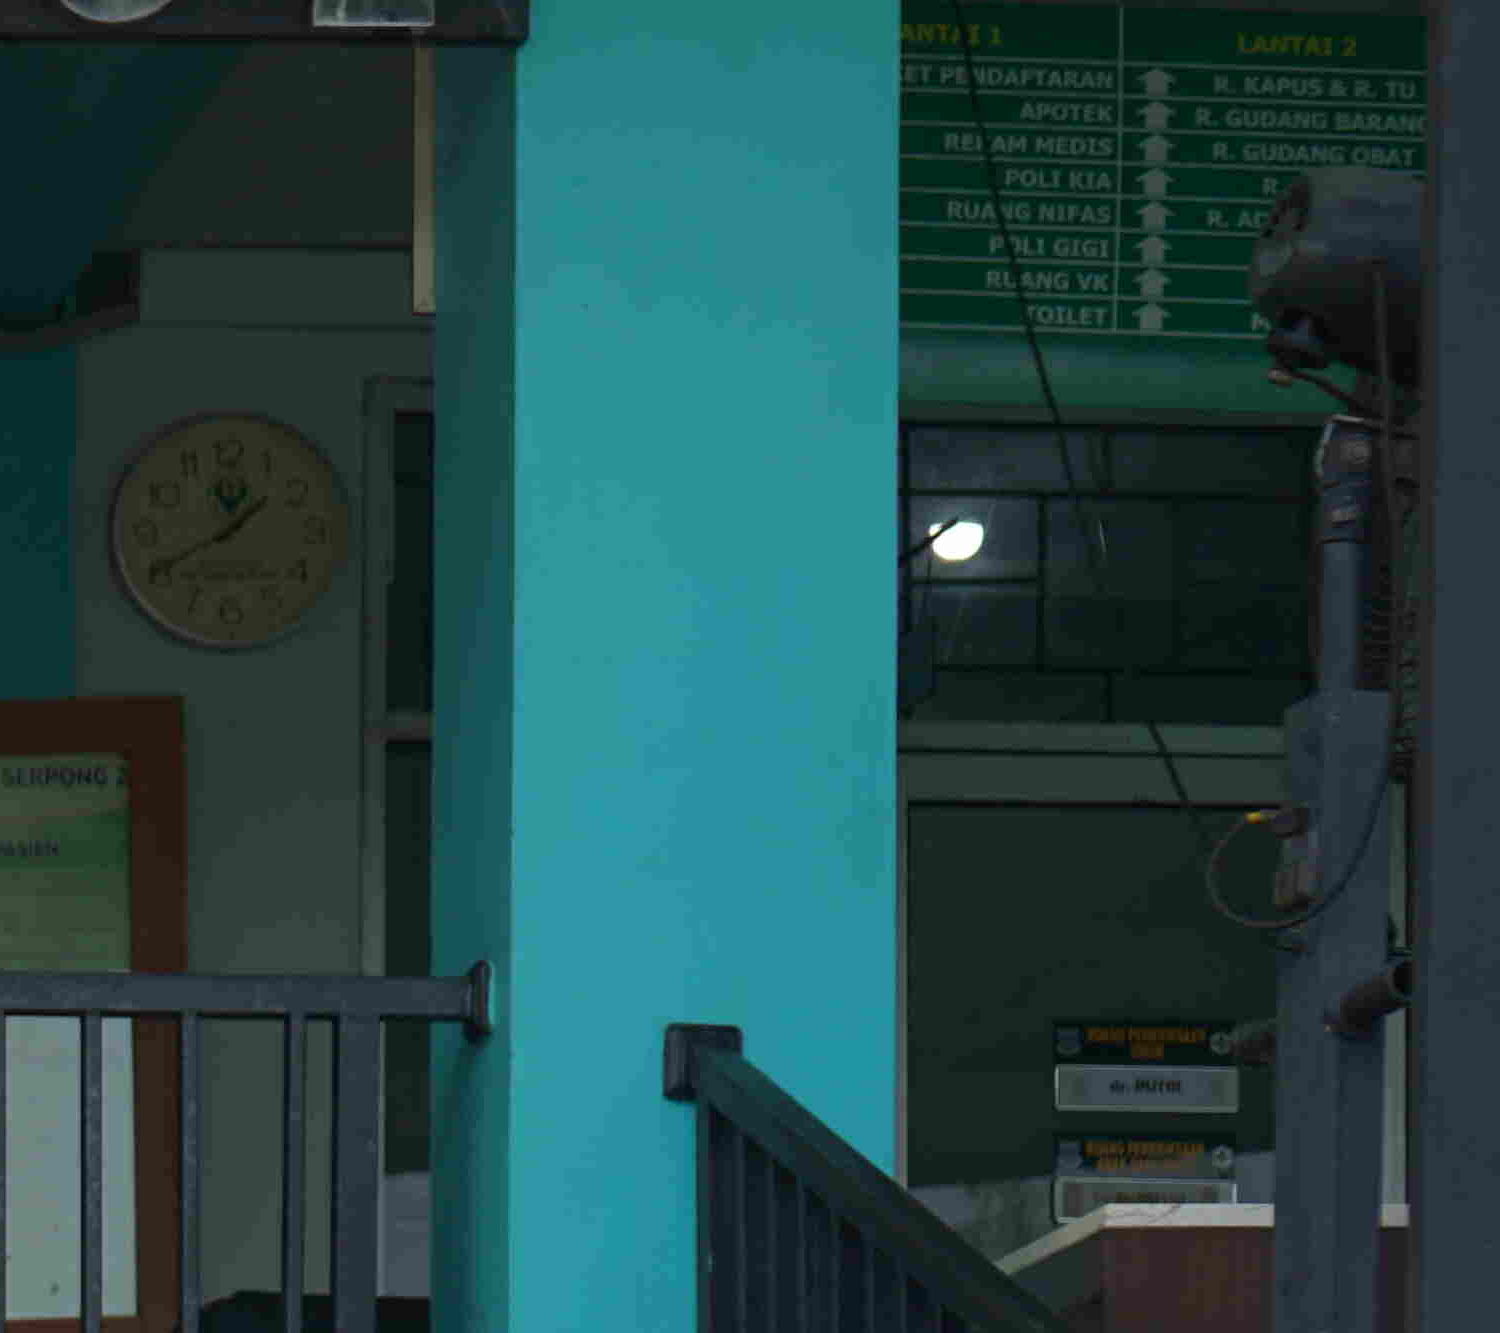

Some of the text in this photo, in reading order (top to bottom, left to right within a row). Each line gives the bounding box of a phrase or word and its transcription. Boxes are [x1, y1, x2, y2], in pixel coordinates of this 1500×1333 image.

[899, 24, 981, 47] ANTAI
[1237, 33, 1357, 57] LANTAI 2
[940, 65, 1113, 90] PENDAFTARAN
[1243, 75, 1324, 98] KAPUS
[1382, 79, 1416, 101] TU
[1019, 101, 1113, 123] APOTEK
[1224, 108, 1328, 130] GUDANG
[1034, 135, 1114, 157] MEDIS
[1243, 142, 1347, 165] GUDANG
[1351, 145, 1415, 168] OBAT
[1004, 168, 1113, 193] POLI KIA
[947, 200, 1112, 225] RUANG NIFAS
[1052, 238, 1110, 260] GIGI
[1076, 271, 1110, 293] VK
[1026, 304, 1109, 327] TOILET
[3, 766, 109, 788] SERPONG
